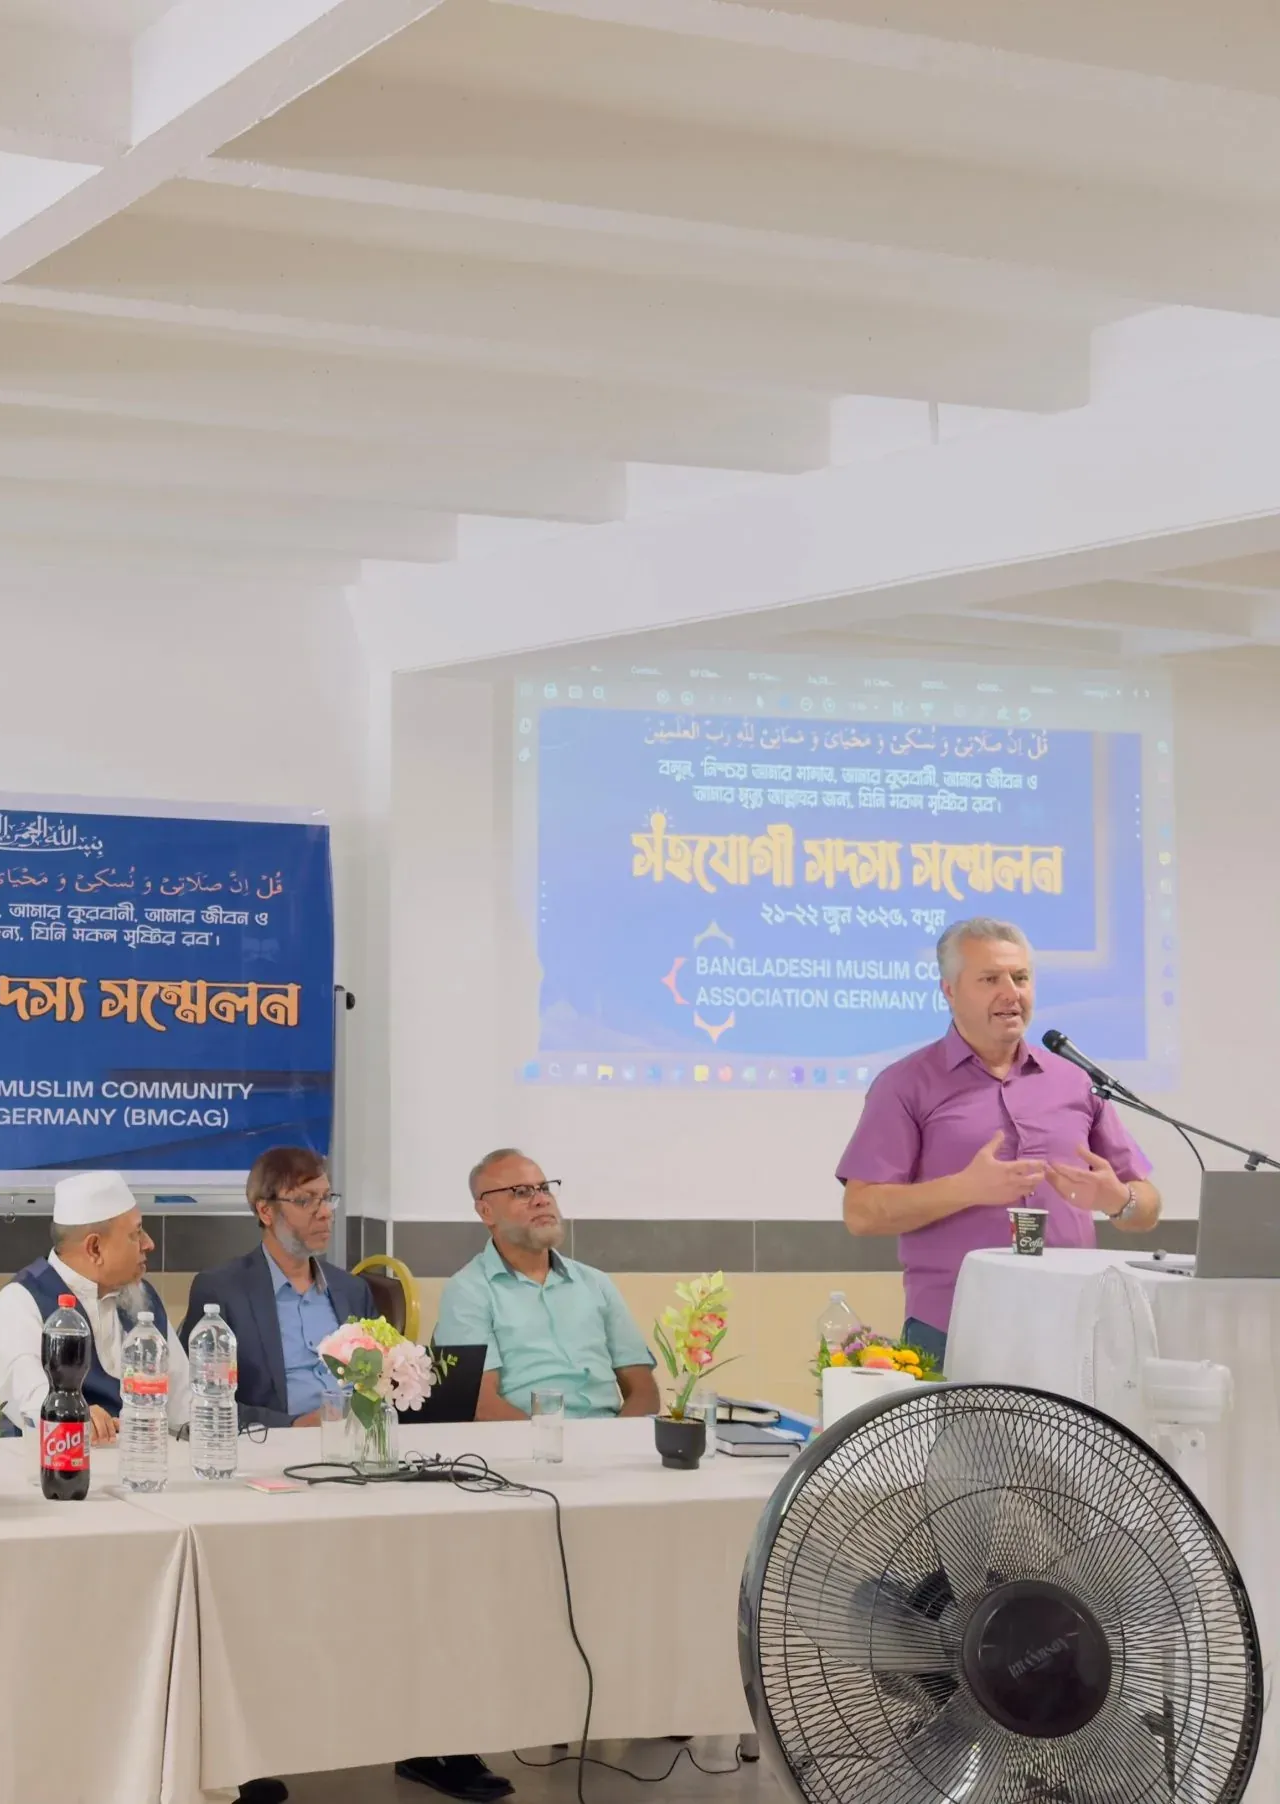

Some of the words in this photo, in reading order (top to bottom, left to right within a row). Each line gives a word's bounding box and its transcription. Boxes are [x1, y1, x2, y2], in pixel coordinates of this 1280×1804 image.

[1027, 774, 1038, 791] ও
[803, 838, 903, 891] সদস্য
[910, 841, 1065, 901] সম্মেলন
[9, 903, 61, 920] আমার
[144, 907, 195, 925] আমার
[201, 905, 249, 926] জীবন
[254, 911, 269, 926] ও
[822, 904, 852, 936] জুন
[30, 921, 67, 942] যিনি
[72, 927, 117, 943] সকল
[122, 924, 176, 948] সৃষ্টির
[695, 956, 832, 979] BANGLADESHI
[835, 960, 910, 981] MUSLIM
[98, 979, 302, 1032] সম্মেলন
[695, 986, 830, 1009] ASSOCIATION
[834, 989, 927, 1011] GERMANY
[101, 1080, 254, 1101] COMMUNITY
[123, 1106, 230, 1129] (BMCAG)
[46, 1431, 81, 1456] Cola
